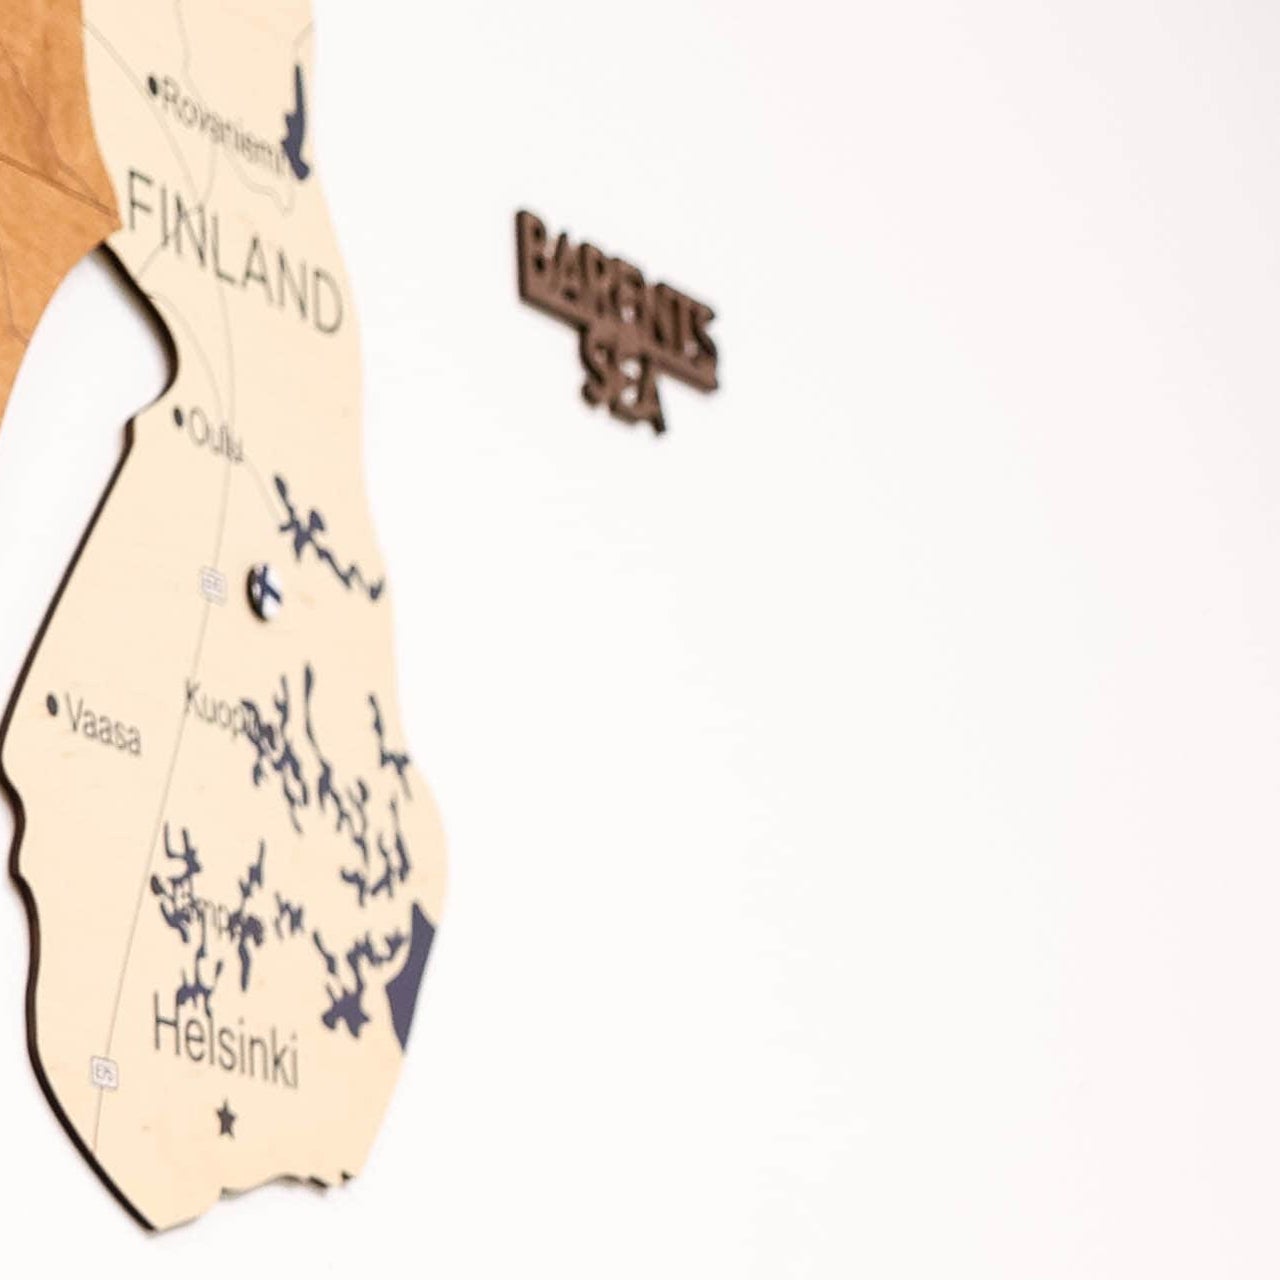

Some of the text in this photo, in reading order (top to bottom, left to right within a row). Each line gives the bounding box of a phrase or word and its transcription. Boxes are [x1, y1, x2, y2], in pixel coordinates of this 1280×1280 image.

[127, 168, 343, 337] FINLAND
[516, 210, 718, 392] BARENTS
[580, 328, 666, 435] SEA
[64, 690, 143, 757] Vaasa
[153, 990, 300, 1090] Helsinki
